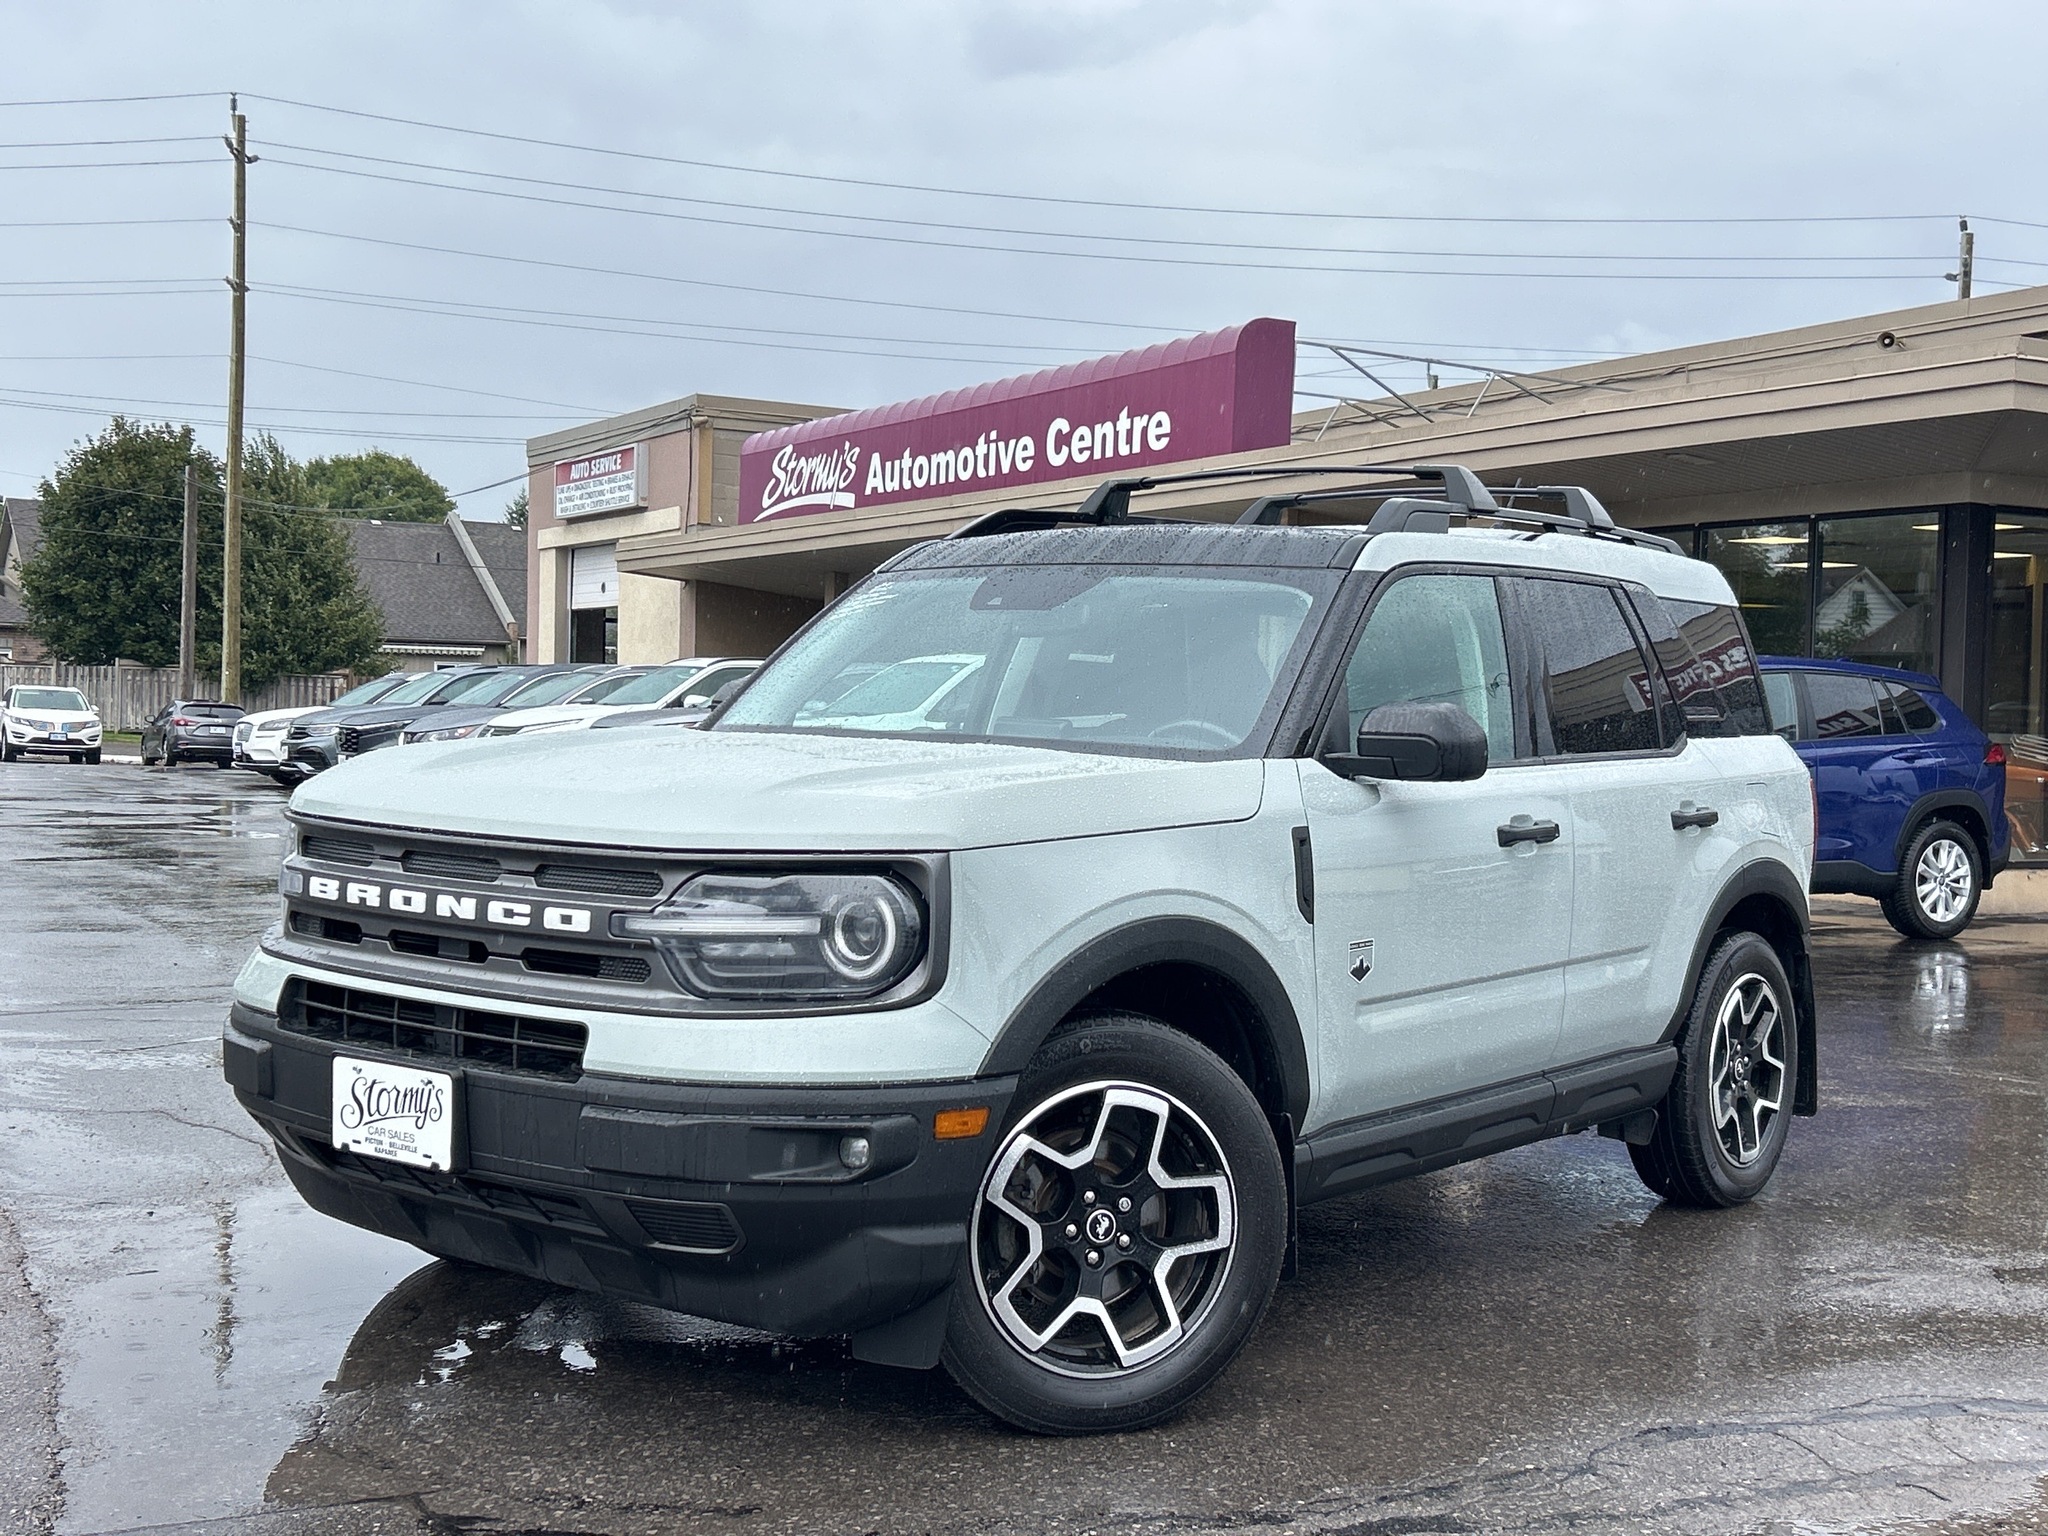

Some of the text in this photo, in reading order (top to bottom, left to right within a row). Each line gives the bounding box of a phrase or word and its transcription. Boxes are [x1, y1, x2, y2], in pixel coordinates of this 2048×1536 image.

[570, 454, 621, 480] AUTO SERVICE
[761, 405, 1171, 509] Stormy's Automotive Centre
[308, 875, 591, 932] BRONCO
[340, 1076, 443, 1130] Stormy's
[367, 1125, 416, 1143] CAR SALES
[388, 1141, 418, 1153] BELLEVILLE
